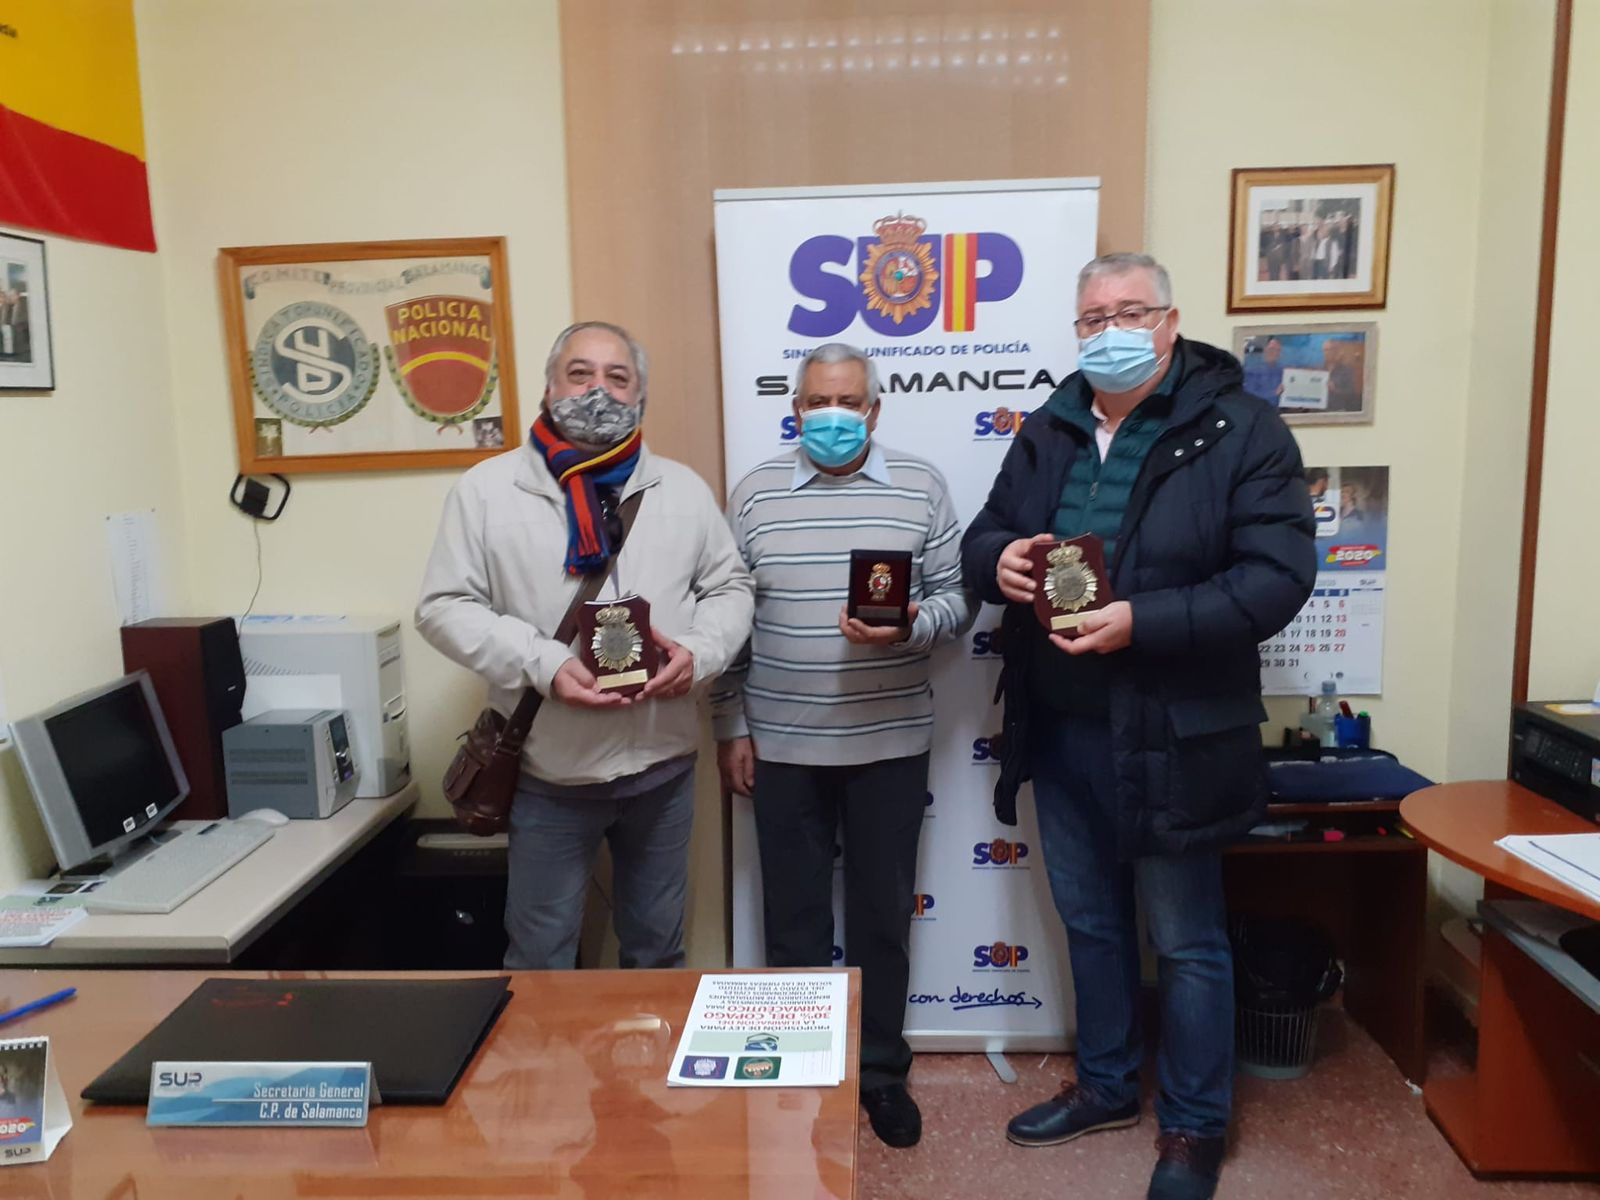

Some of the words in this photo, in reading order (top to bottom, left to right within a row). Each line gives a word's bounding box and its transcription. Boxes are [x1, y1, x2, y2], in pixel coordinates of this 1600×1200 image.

[787, 232, 1024, 338] SUP
[398, 300, 483, 324] POLICIA
[392, 320, 492, 344] NACIONAL
[864, 345, 945, 358] UNIFICADO
[950, 344, 969, 356] DE
[973, 339, 1031, 354] POLICÍA
[1336, 550, 1373, 561] 2020
[1309, 600, 1314, 608] 4
[1324, 600, 1329, 608] 5
[1274, 659, 1285, 667] 30
[973, 842, 1029, 865] SUP
[973, 945, 1029, 968] SUP
[909, 994, 944, 1004] con
[949, 986, 1026, 1004] derechos
[159, 1072, 202, 1087] SUP
[319, 1081, 364, 1098] General
[259, 1103, 281, 1119] C.P.
[284, 1103, 298, 1119] de
[301, 1102, 362, 1119] Salamanca
